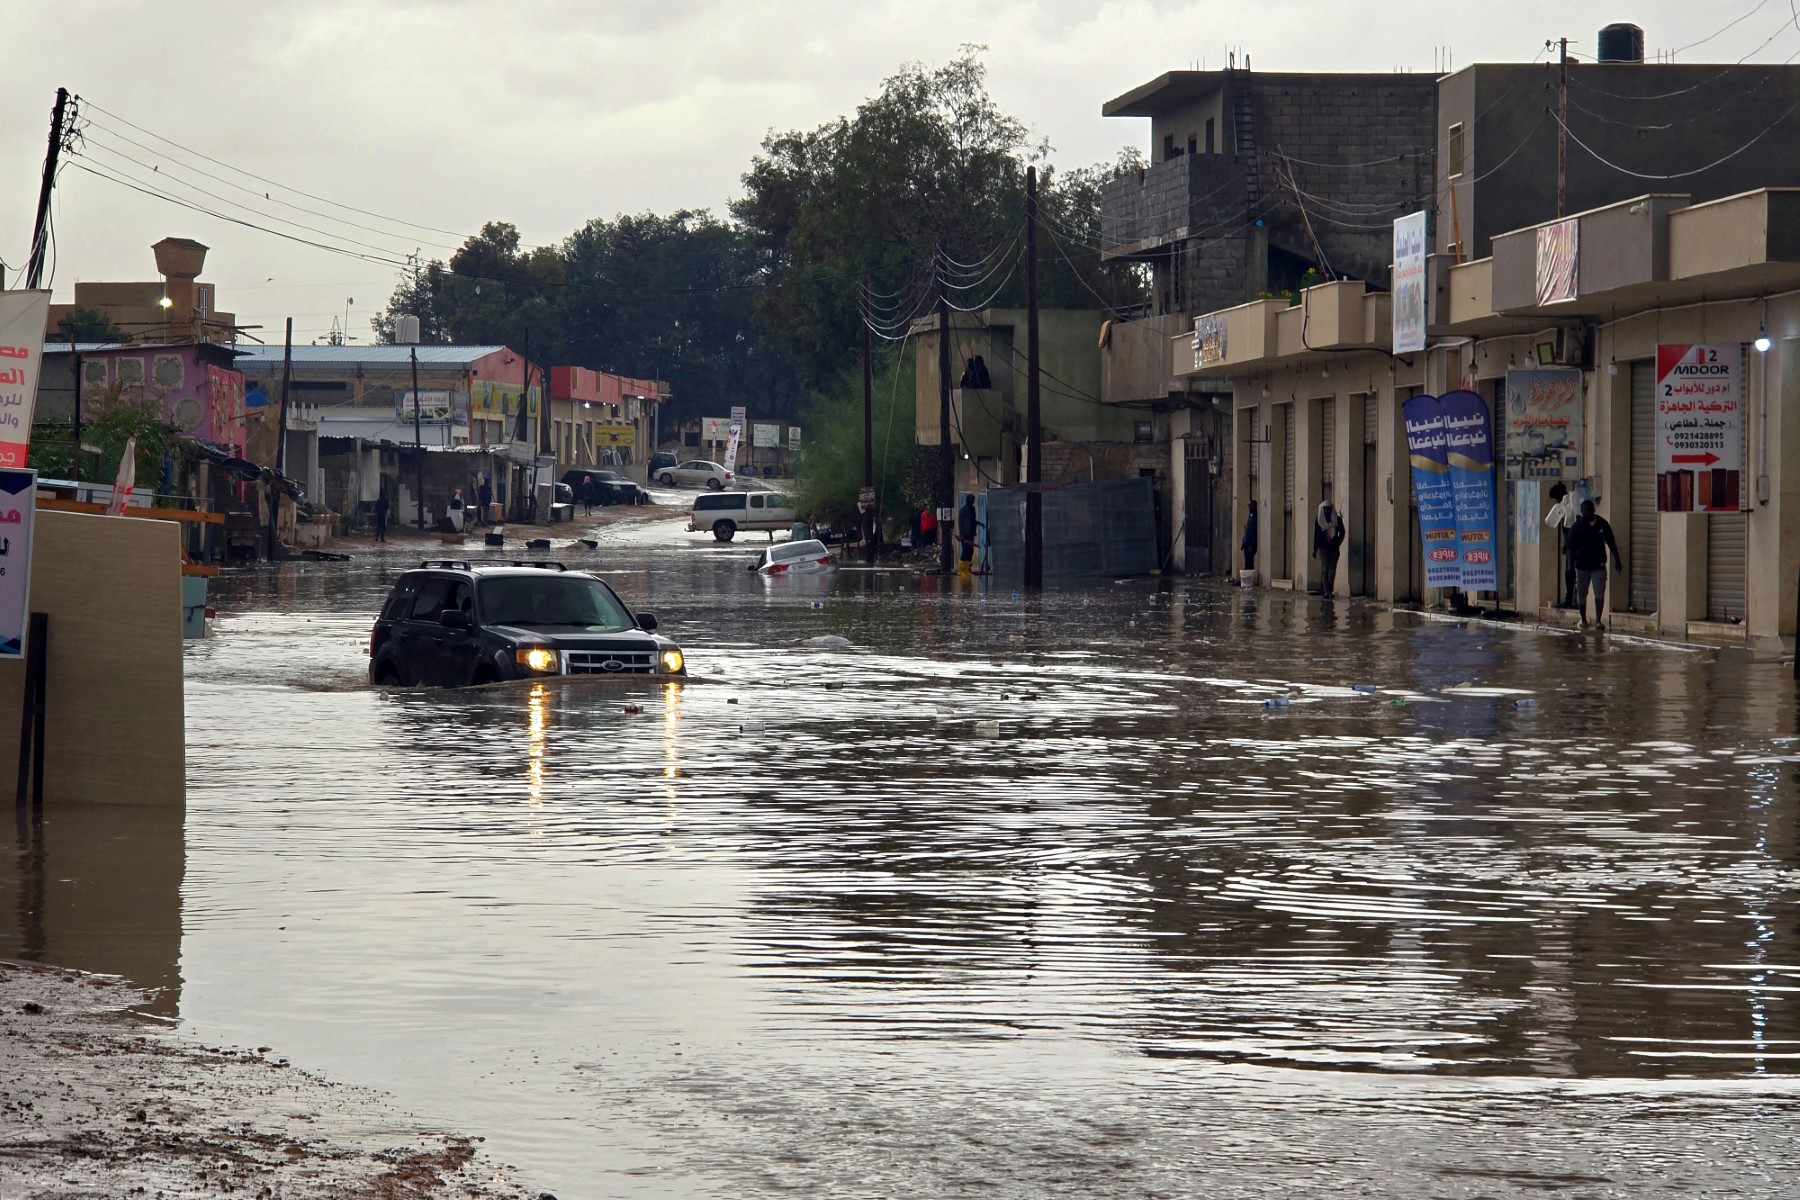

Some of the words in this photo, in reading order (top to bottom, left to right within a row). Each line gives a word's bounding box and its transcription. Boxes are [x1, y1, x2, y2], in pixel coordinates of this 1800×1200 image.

[1709, 350, 1717, 362] 2
[1674, 365, 1729, 375] MDOOR
[1664, 384, 1673, 396] 2
[1673, 383, 1705, 397] للأبواب
[1706, 386, 1720, 396] دور
[1659, 400, 1696, 415] الجاهزة
[1698, 400, 1737, 414] التركية
[1674, 432, 1724, 440] 0921428895
[1674, 441, 1724, 449] 0930320313
